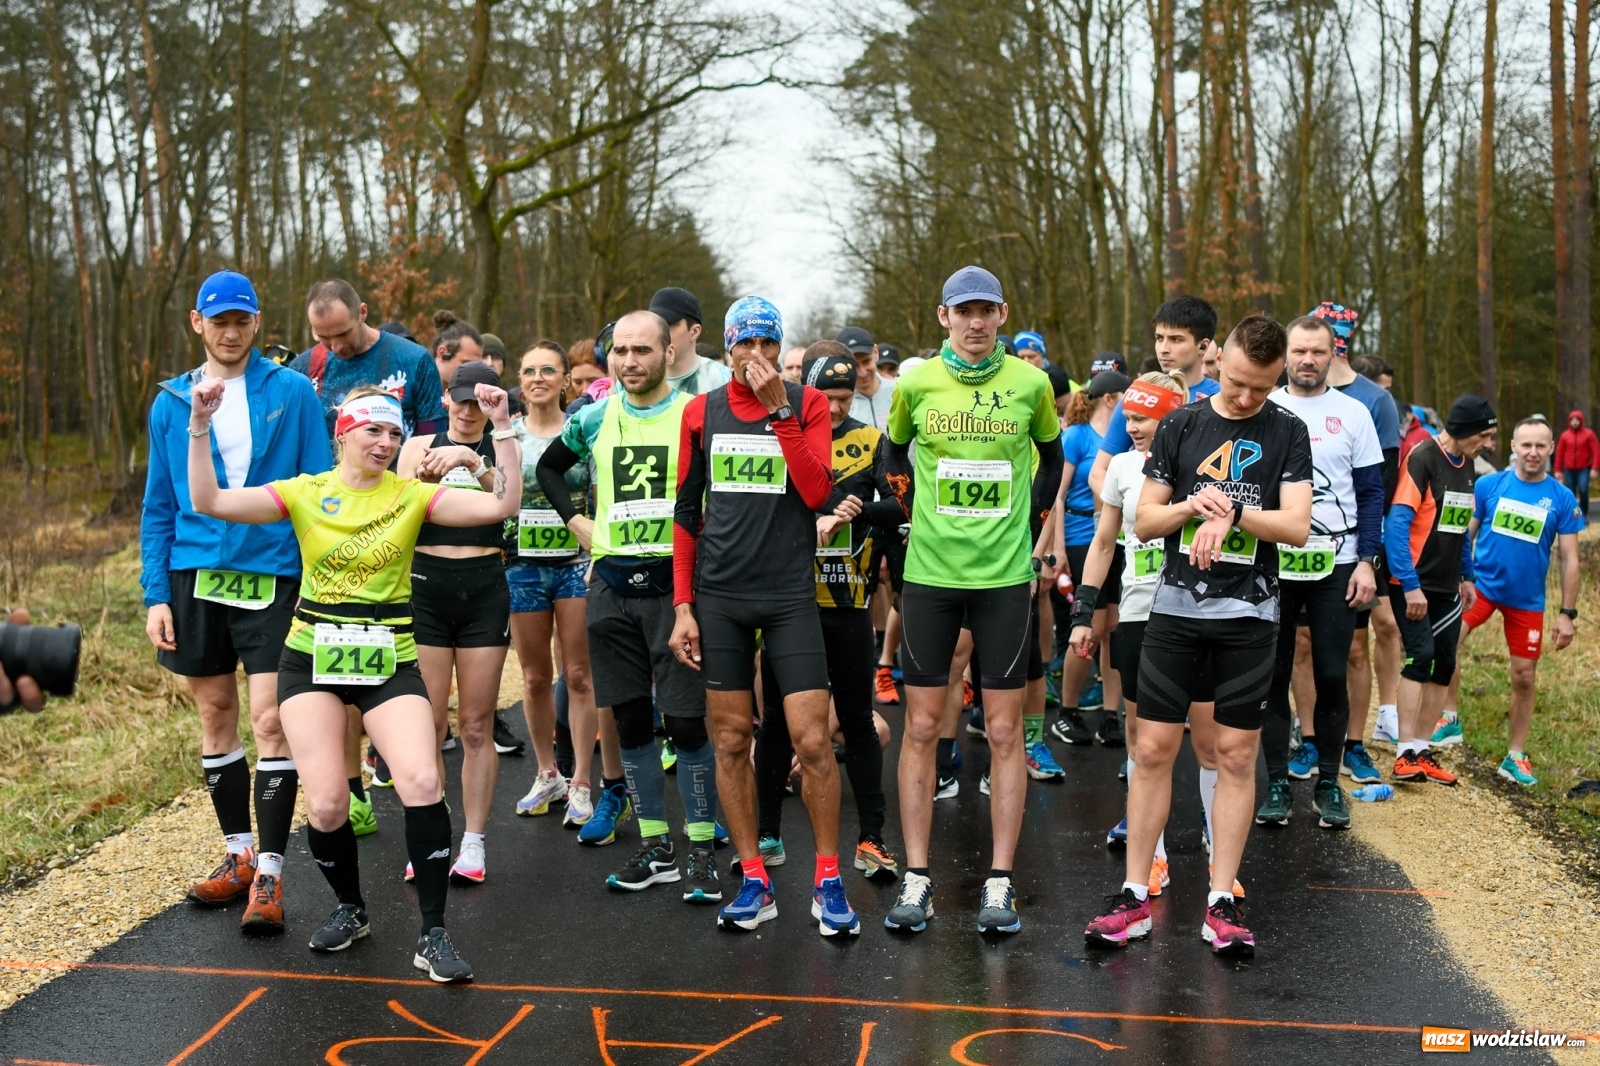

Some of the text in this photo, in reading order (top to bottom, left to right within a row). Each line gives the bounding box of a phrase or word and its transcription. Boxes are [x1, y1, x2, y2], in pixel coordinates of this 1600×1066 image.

[926, 409, 1018, 435] Radlinioki
[961, 434, 996, 443] biegu
[723, 456, 774, 483] 144
[949, 482, 1000, 507] 194
[619, 519, 666, 546] 127
[1501, 513, 1535, 535] 196
[310, 504, 405, 595] JEJKOWICE
[527, 528, 570, 548] 199
[823, 563, 852, 572] BIEG
[1281, 552, 1325, 572] 218
[207, 573, 262, 600] 241
[326, 647, 385, 674] 214
